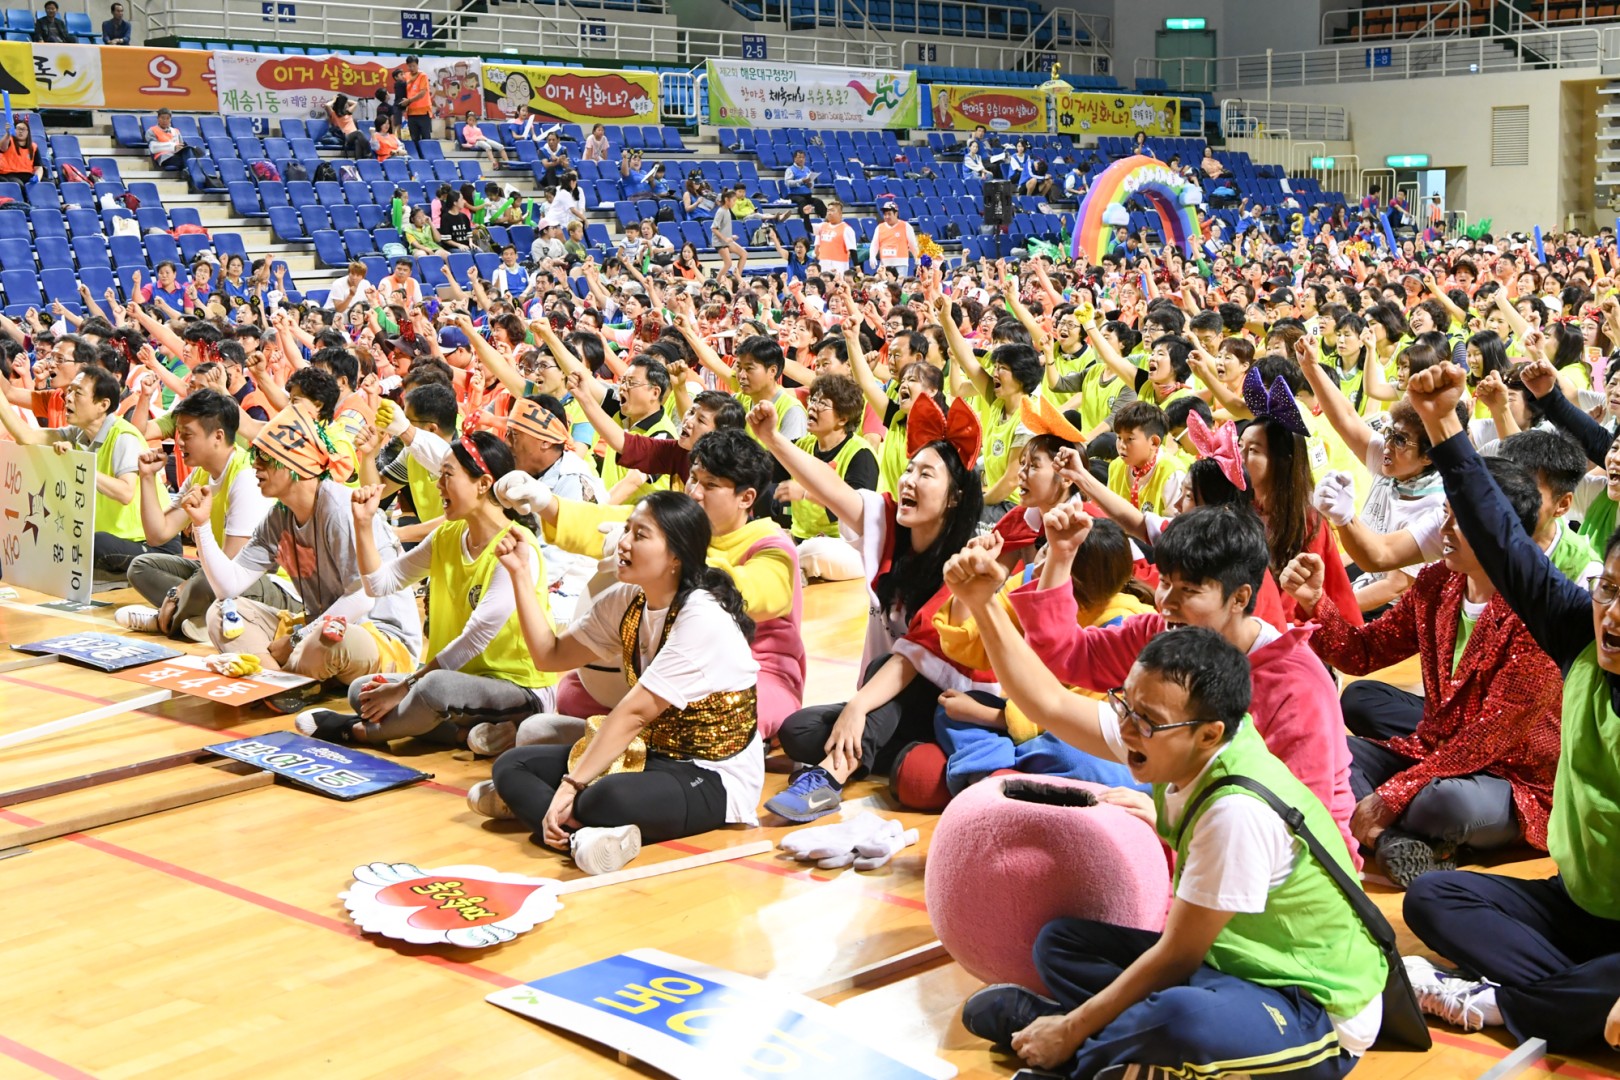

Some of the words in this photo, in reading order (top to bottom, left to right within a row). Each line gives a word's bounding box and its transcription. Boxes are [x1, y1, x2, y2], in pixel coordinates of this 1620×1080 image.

[403, 12, 418, 20] Block
[406, 22, 428, 38] 2-4
[745, 44, 764, 58] 2-5
[273, 65, 314, 83] 이거
[321, 61, 389, 90] 실화냐?
[719, 66, 739, 78] 제2회
[740, 67, 797, 82] 해운대구청장기
[545, 83, 575, 101] 이거
[579, 82, 629, 109] 실화냐?
[768, 86, 805, 107] 체육대회
[729, 107, 757, 119] 반송1동
[986, 103, 1001, 117] 우승!
[1002, 106, 1014, 115] 이거
[1016, 103, 1037, 118] 실화냐?
[225, 741, 370, 788] 반여1동
[412, 880, 498, 921] 재송2동
